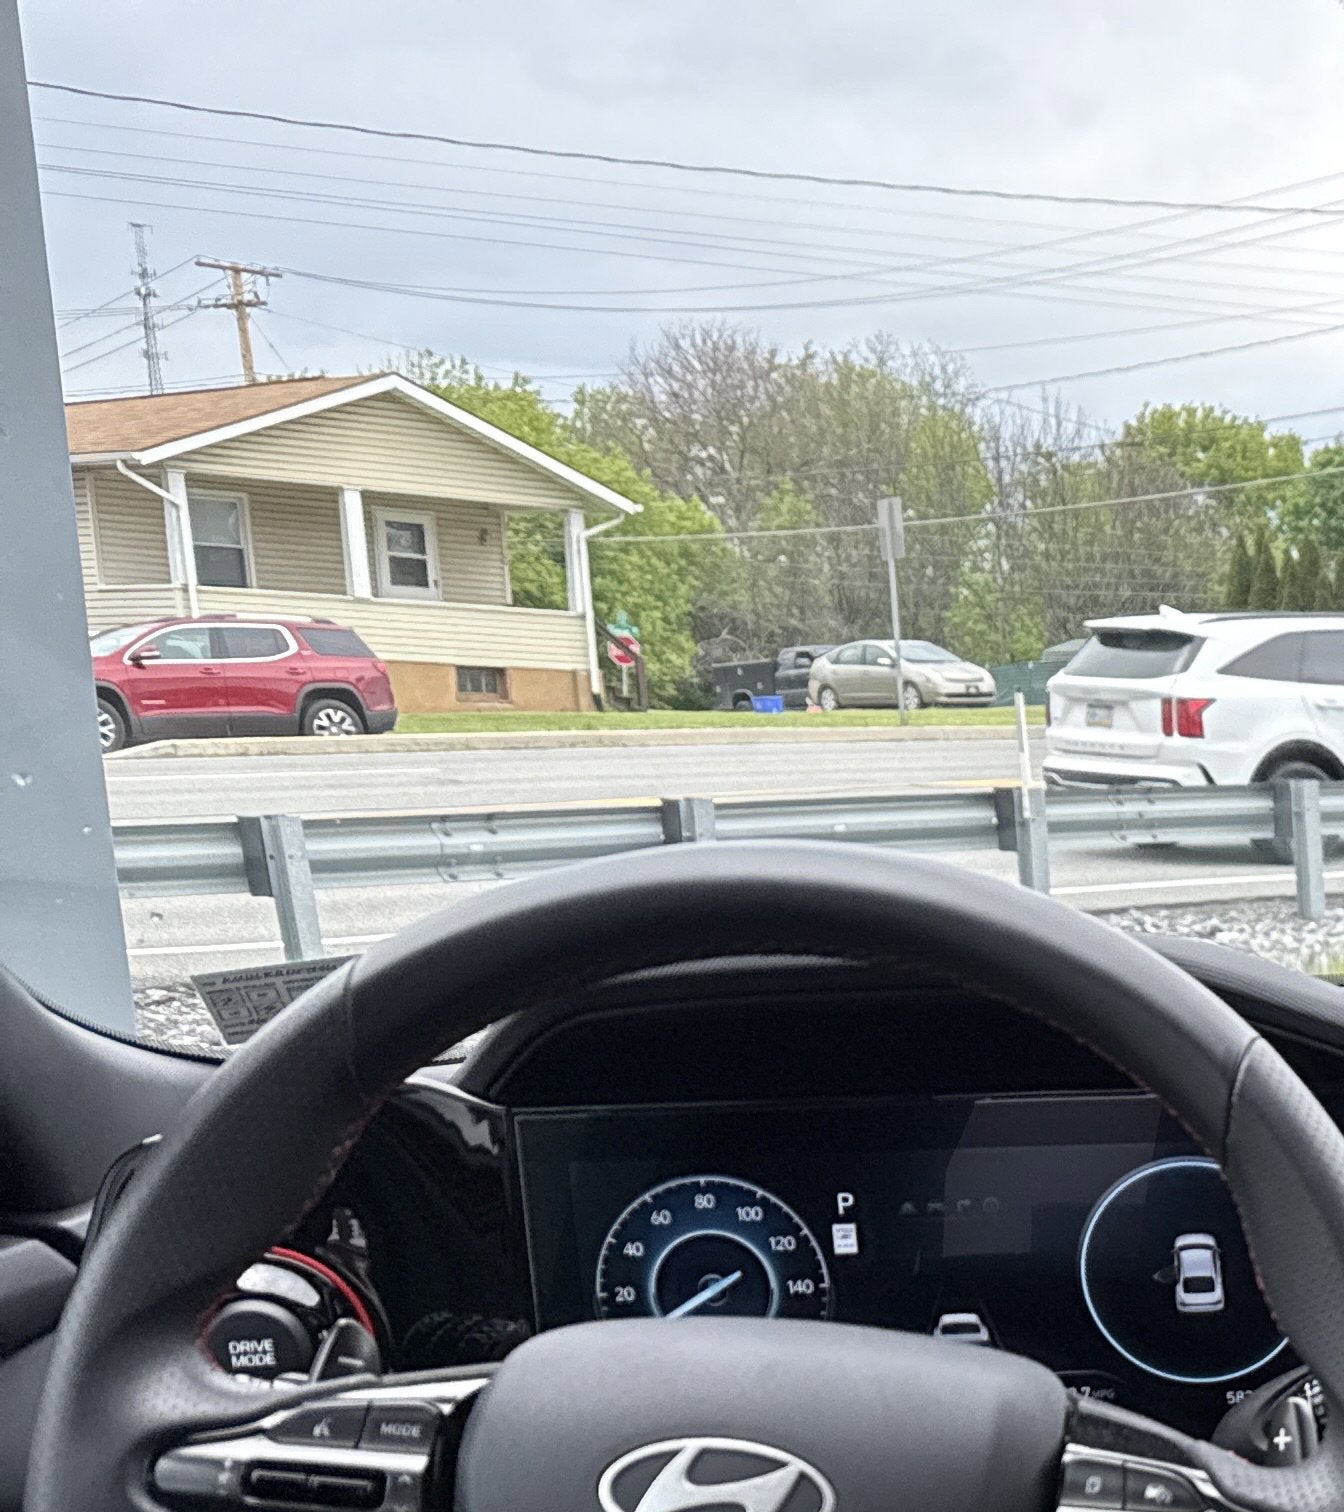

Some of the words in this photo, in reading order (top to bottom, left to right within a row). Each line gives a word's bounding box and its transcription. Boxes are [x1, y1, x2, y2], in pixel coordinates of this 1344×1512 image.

[694, 1193, 716, 1209] 80
[836, 1192, 855, 1216] P
[650, 1209, 673, 1225] 60
[735, 1206, 763, 1222] 100
[623, 1242, 645, 1258] 40
[768, 1235, 798, 1251] 120
[614, 1286, 637, 1303] 20
[786, 1278, 815, 1295] 140
[228, 1338, 275, 1354] DRIVE
[230, 1353, 276, 1369] MODE
[380, 1422, 421, 1438] MODE
